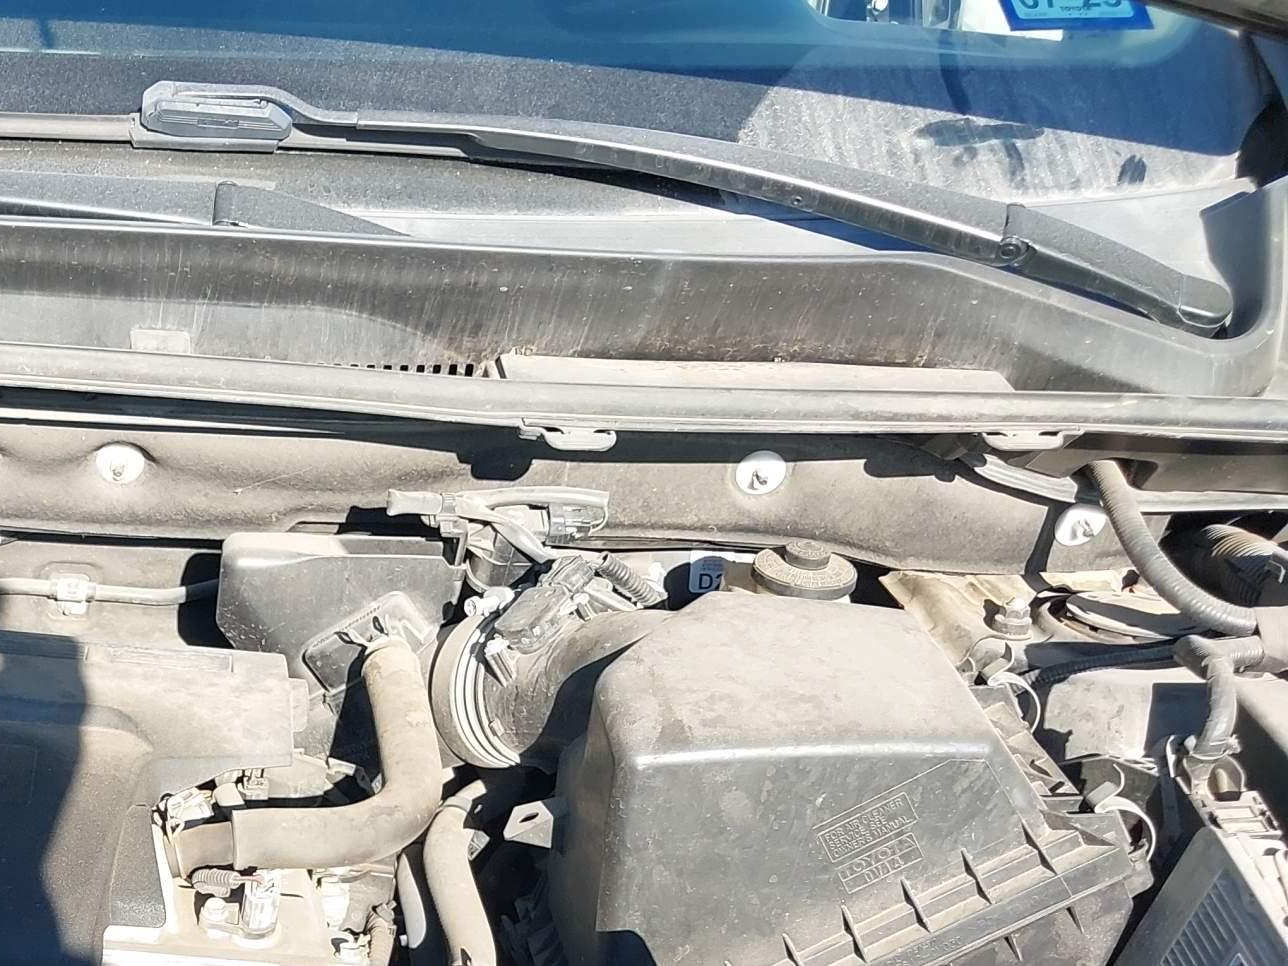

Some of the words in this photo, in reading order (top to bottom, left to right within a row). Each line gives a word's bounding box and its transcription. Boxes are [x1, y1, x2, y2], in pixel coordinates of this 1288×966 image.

[825, 827, 845, 842] FOR
[862, 798, 903, 824] CLEANER
[870, 816, 888, 830] SEE
[873, 815, 914, 837] MANUAL
[844, 837, 915, 876] TOYOTA
